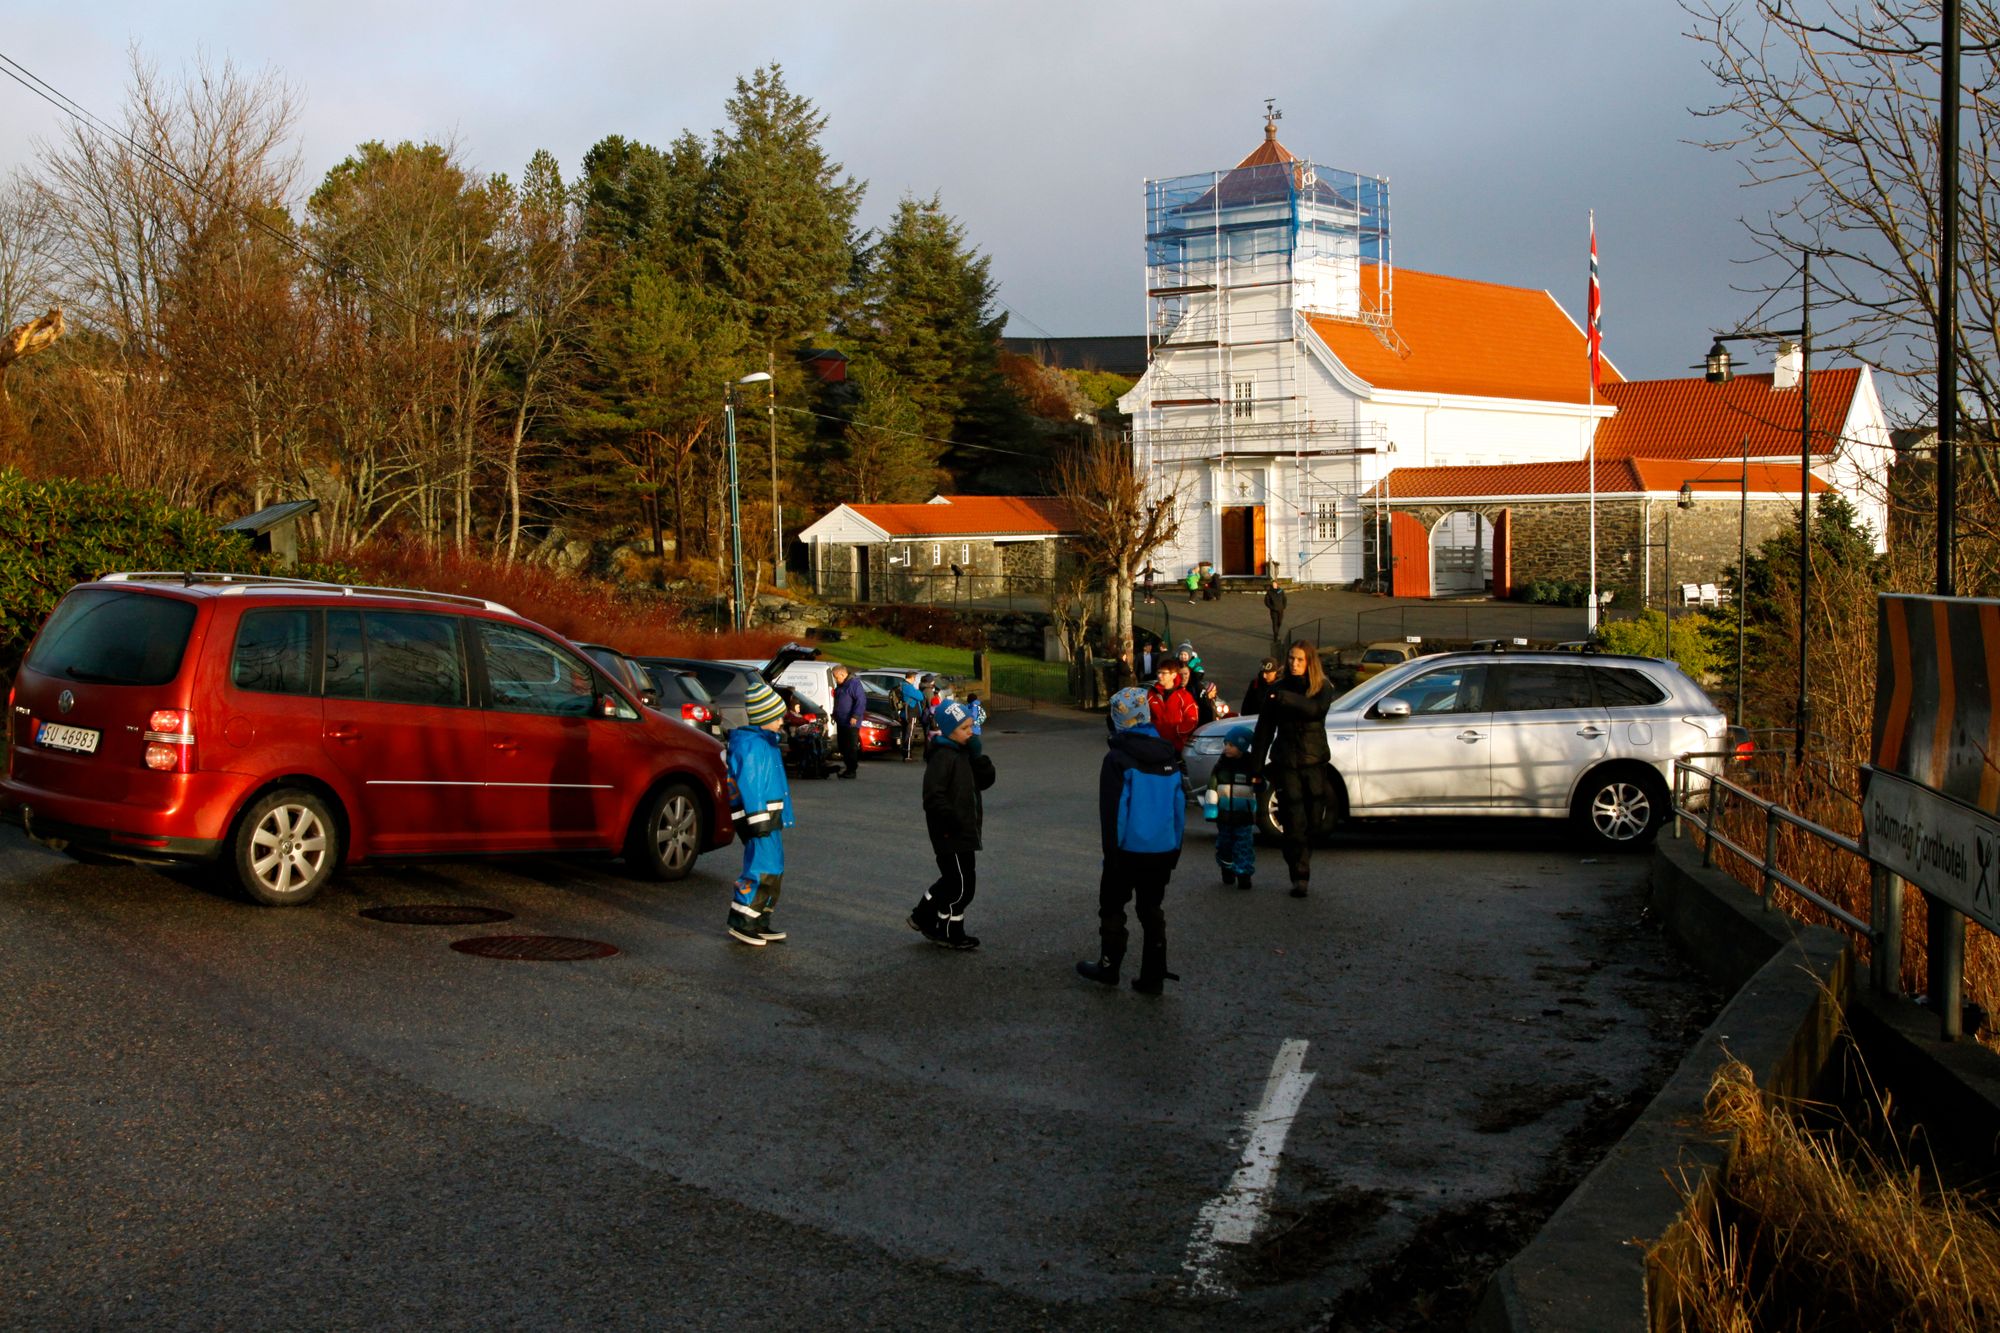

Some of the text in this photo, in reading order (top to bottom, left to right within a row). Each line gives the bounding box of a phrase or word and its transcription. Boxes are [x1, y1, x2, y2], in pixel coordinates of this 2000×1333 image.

[44, 726, 96, 748] SU 46983
[1875, 801, 1914, 860] Blomvåg
